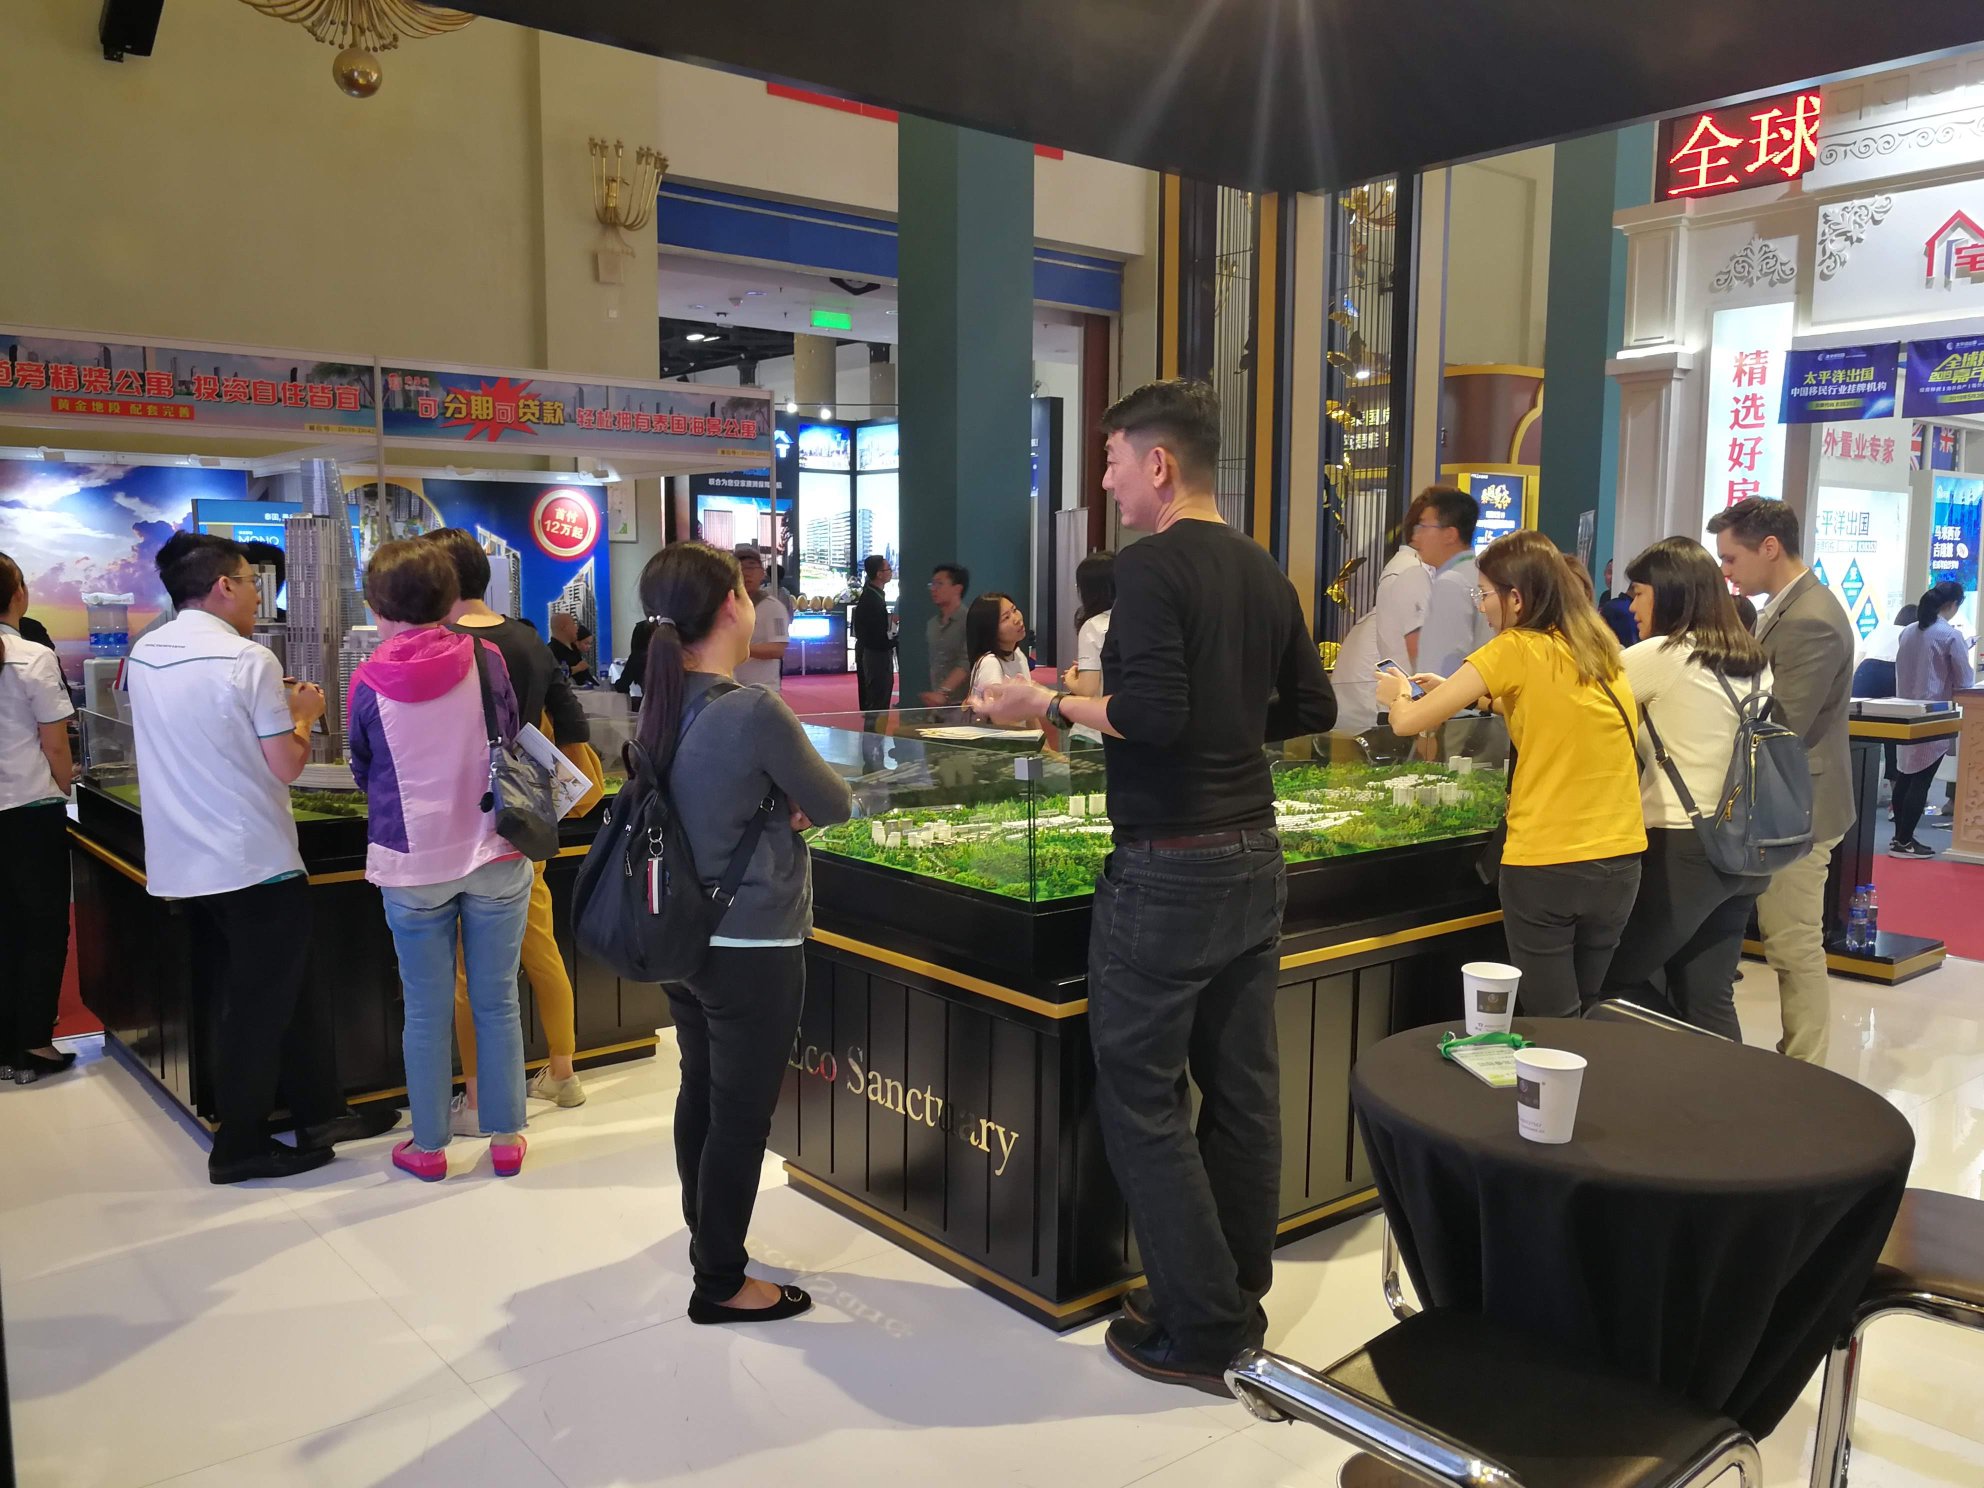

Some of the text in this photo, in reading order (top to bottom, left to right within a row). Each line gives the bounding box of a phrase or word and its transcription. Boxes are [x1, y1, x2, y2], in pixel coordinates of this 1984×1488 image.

[1667, 94, 1821, 196] 全球
[1934, 351, 1984, 372] 全球
[1803, 367, 1875, 385] 太平洋出国
[192, 375, 361, 411] 投资自住皆宜
[1790, 381, 1888, 397] 中国移民行业挂牌机构
[57, 399, 191, 418] 黄金地段 配套完善
[418, 393, 757, 439] 可分期可贷款 轻松拥有泰国海景公寓
[1824, 428, 1896, 464] 外置业专家
[555, 507, 578, 524] 首付
[544, 519, 584, 540] 12万起
[1934, 525, 1961, 541] 马来西亚
[788, 1026, 1019, 1176] Eco Sanctuary
